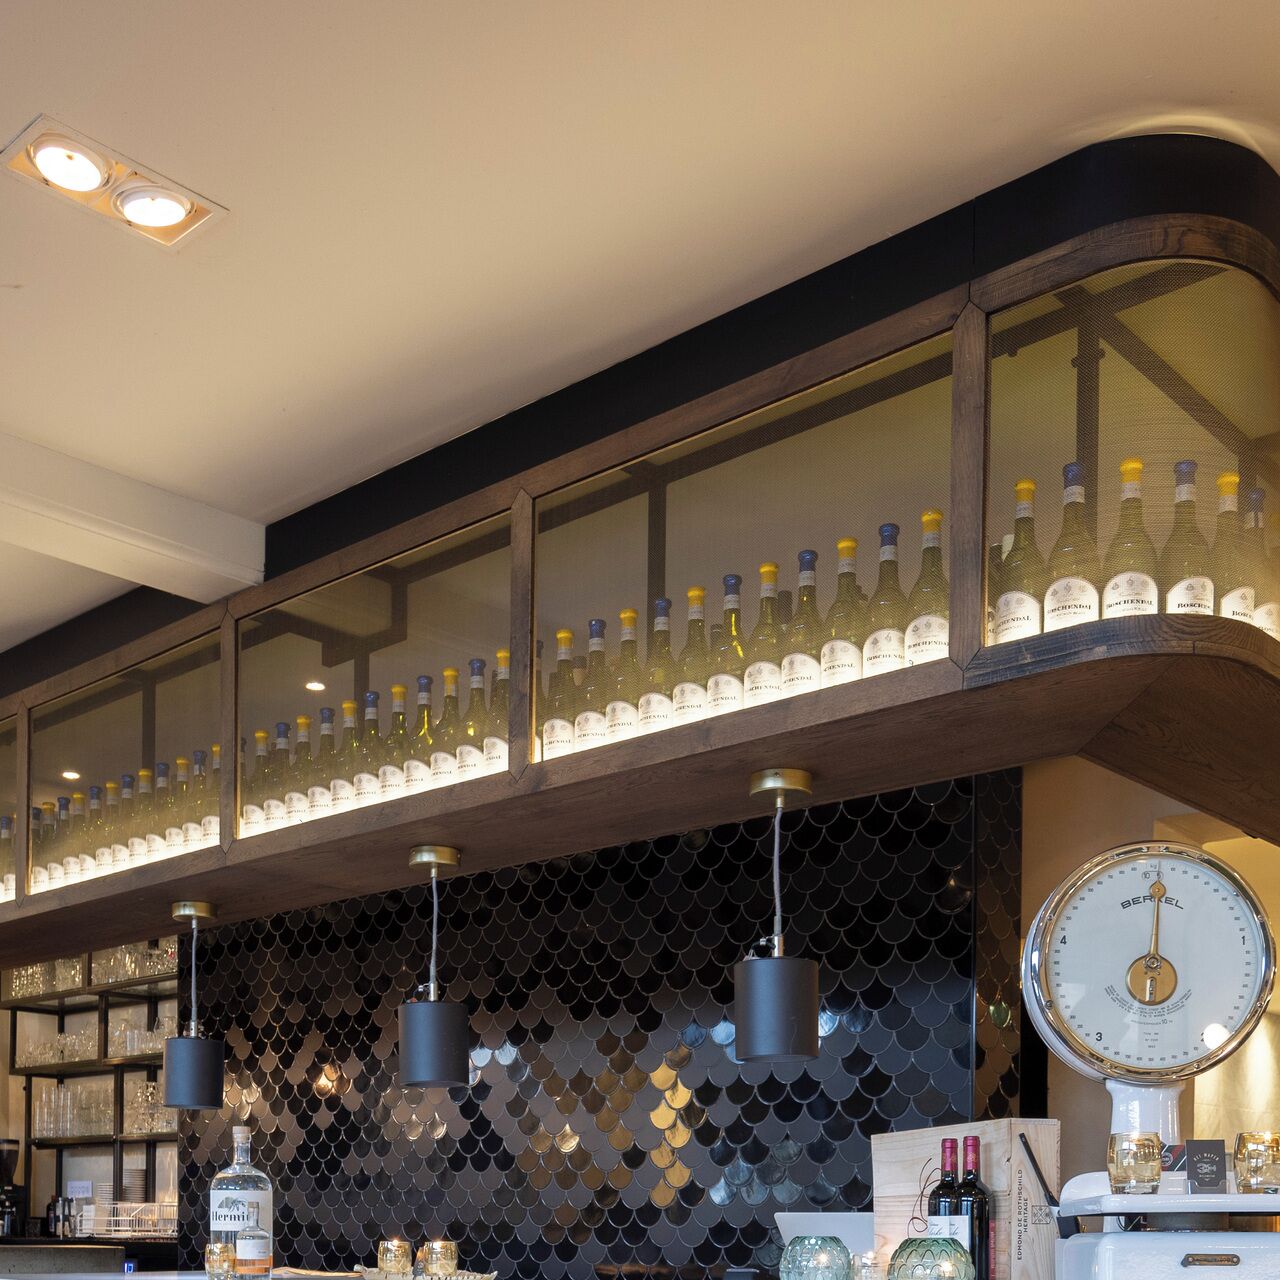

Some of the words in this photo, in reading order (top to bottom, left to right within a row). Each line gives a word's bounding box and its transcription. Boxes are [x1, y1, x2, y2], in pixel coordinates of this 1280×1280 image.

[1060, 935, 1067, 945] 4
[1241, 935, 1246, 946] 1
[1095, 1032, 1103, 1042] 3
[1017, 1217, 1023, 1228] DE
